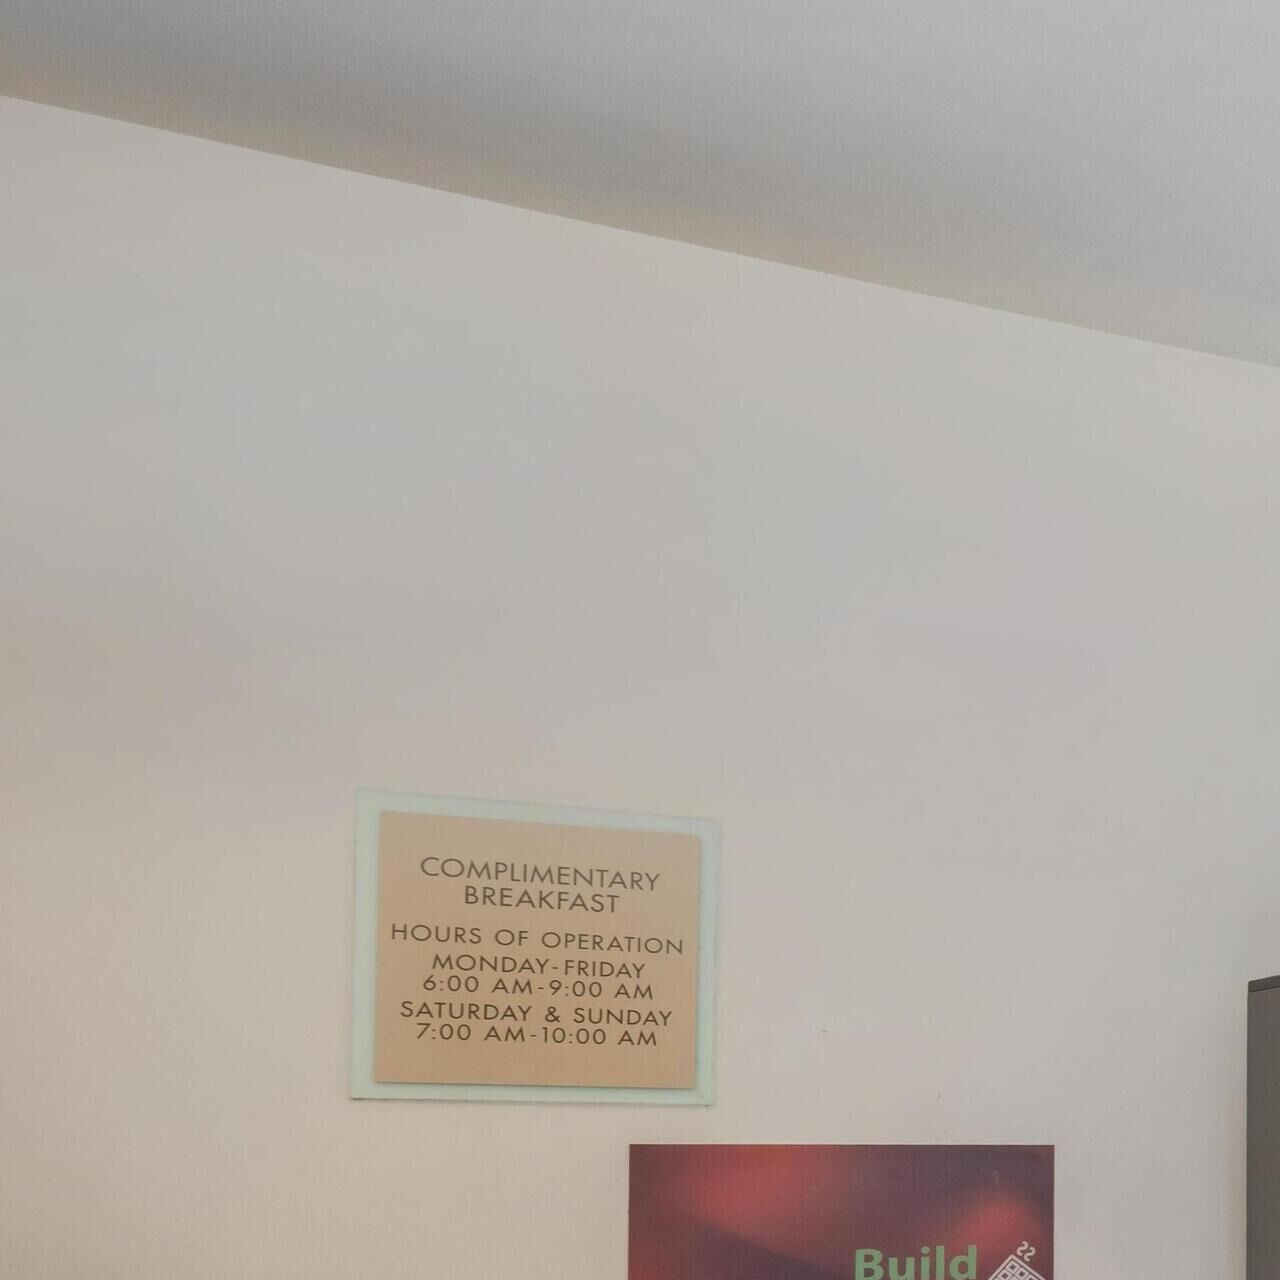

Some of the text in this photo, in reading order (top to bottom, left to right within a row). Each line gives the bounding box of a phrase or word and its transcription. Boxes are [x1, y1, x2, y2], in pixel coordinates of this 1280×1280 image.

[420, 856, 661, 892] COMPLIMENTARY
[464, 885, 620, 913] BREAKFAST
[390, 923, 684, 955] HOURS OF OPERATION
[432, 954, 646, 979] MONDAY-FRIDAY
[422, 975, 654, 1000] 6:00 AM-9:00 AM
[399, 1001, 673, 1026] SATURDAY & SUNDAY
[416, 1023, 657, 1047] 7:00 AM-10:00 AM
